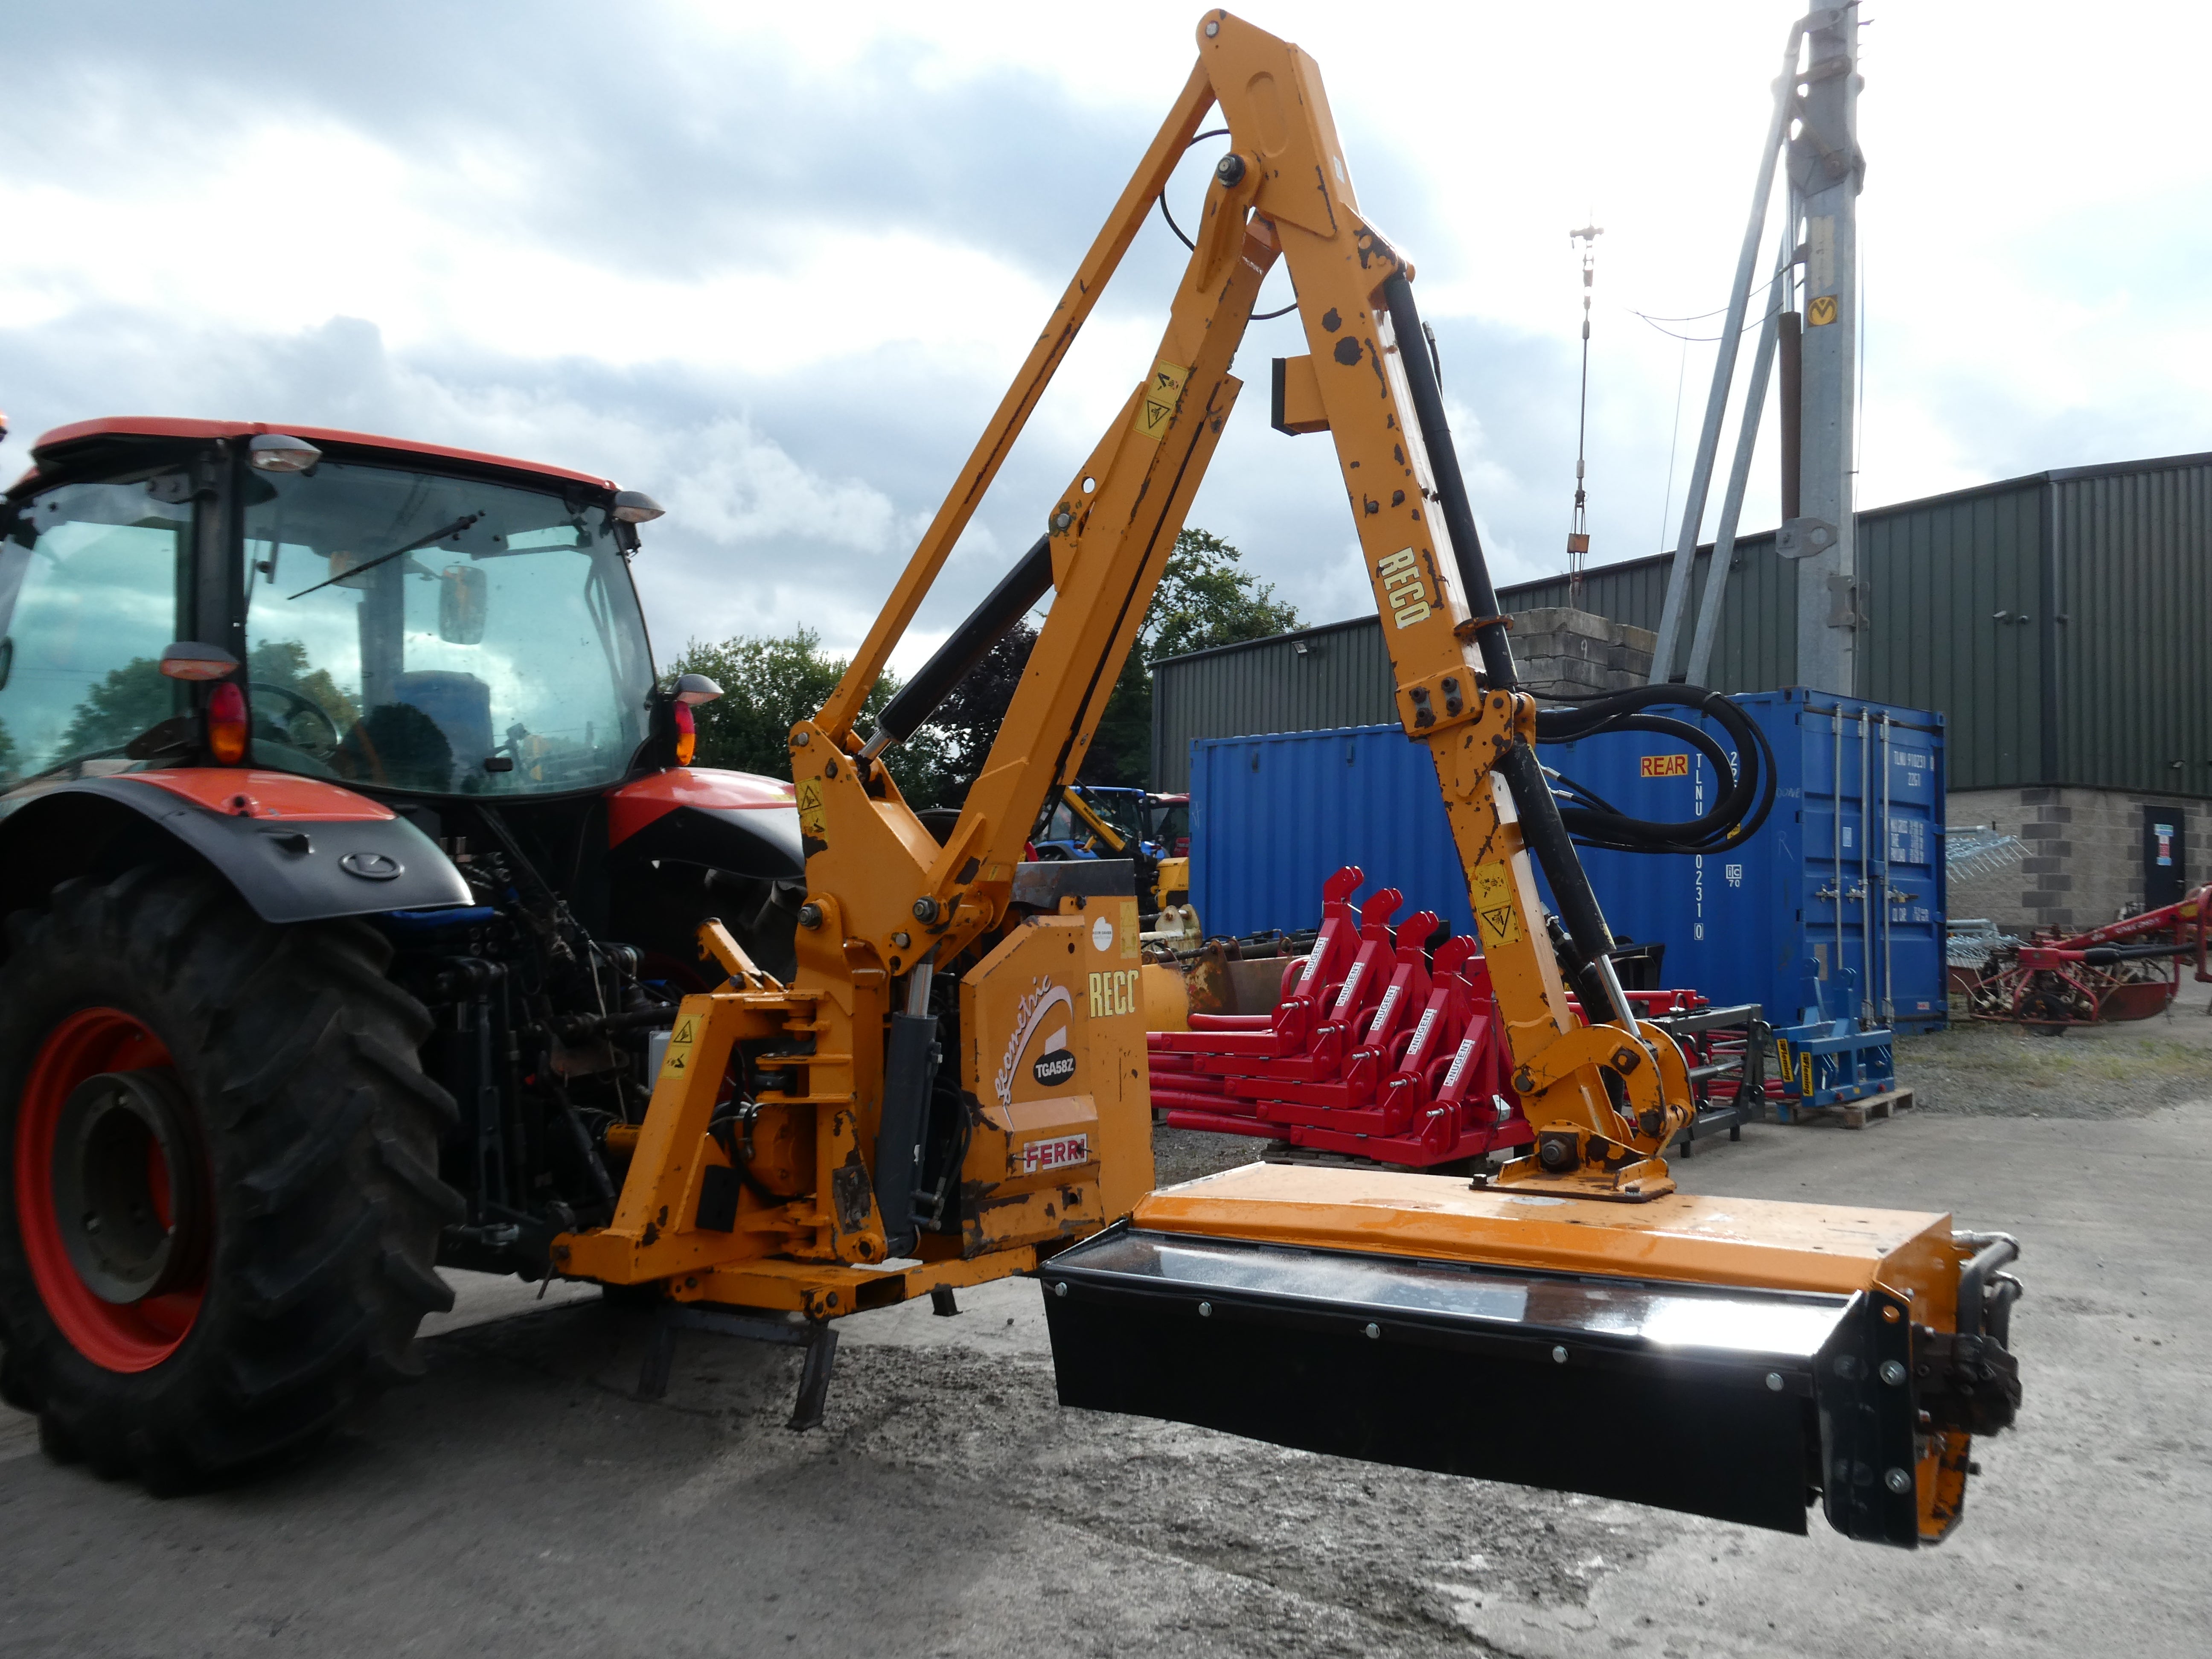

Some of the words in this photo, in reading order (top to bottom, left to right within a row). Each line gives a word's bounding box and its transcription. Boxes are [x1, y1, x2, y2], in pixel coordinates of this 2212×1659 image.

[1378, 546, 1431, 629] RECO
[1642, 756, 1686, 775] REAR
[1306, 938, 1324, 972] NUGENT
[1340, 963, 1360, 998] NUGENT
[1375, 986, 1395, 1022] NUGENT
[1412, 1010, 1432, 1046] NUGENT
[1035, 1058, 1074, 1078] TGA58Z
[1448, 1040, 1470, 1077] NUGENT
[1026, 1138, 1085, 1168] FERRI
